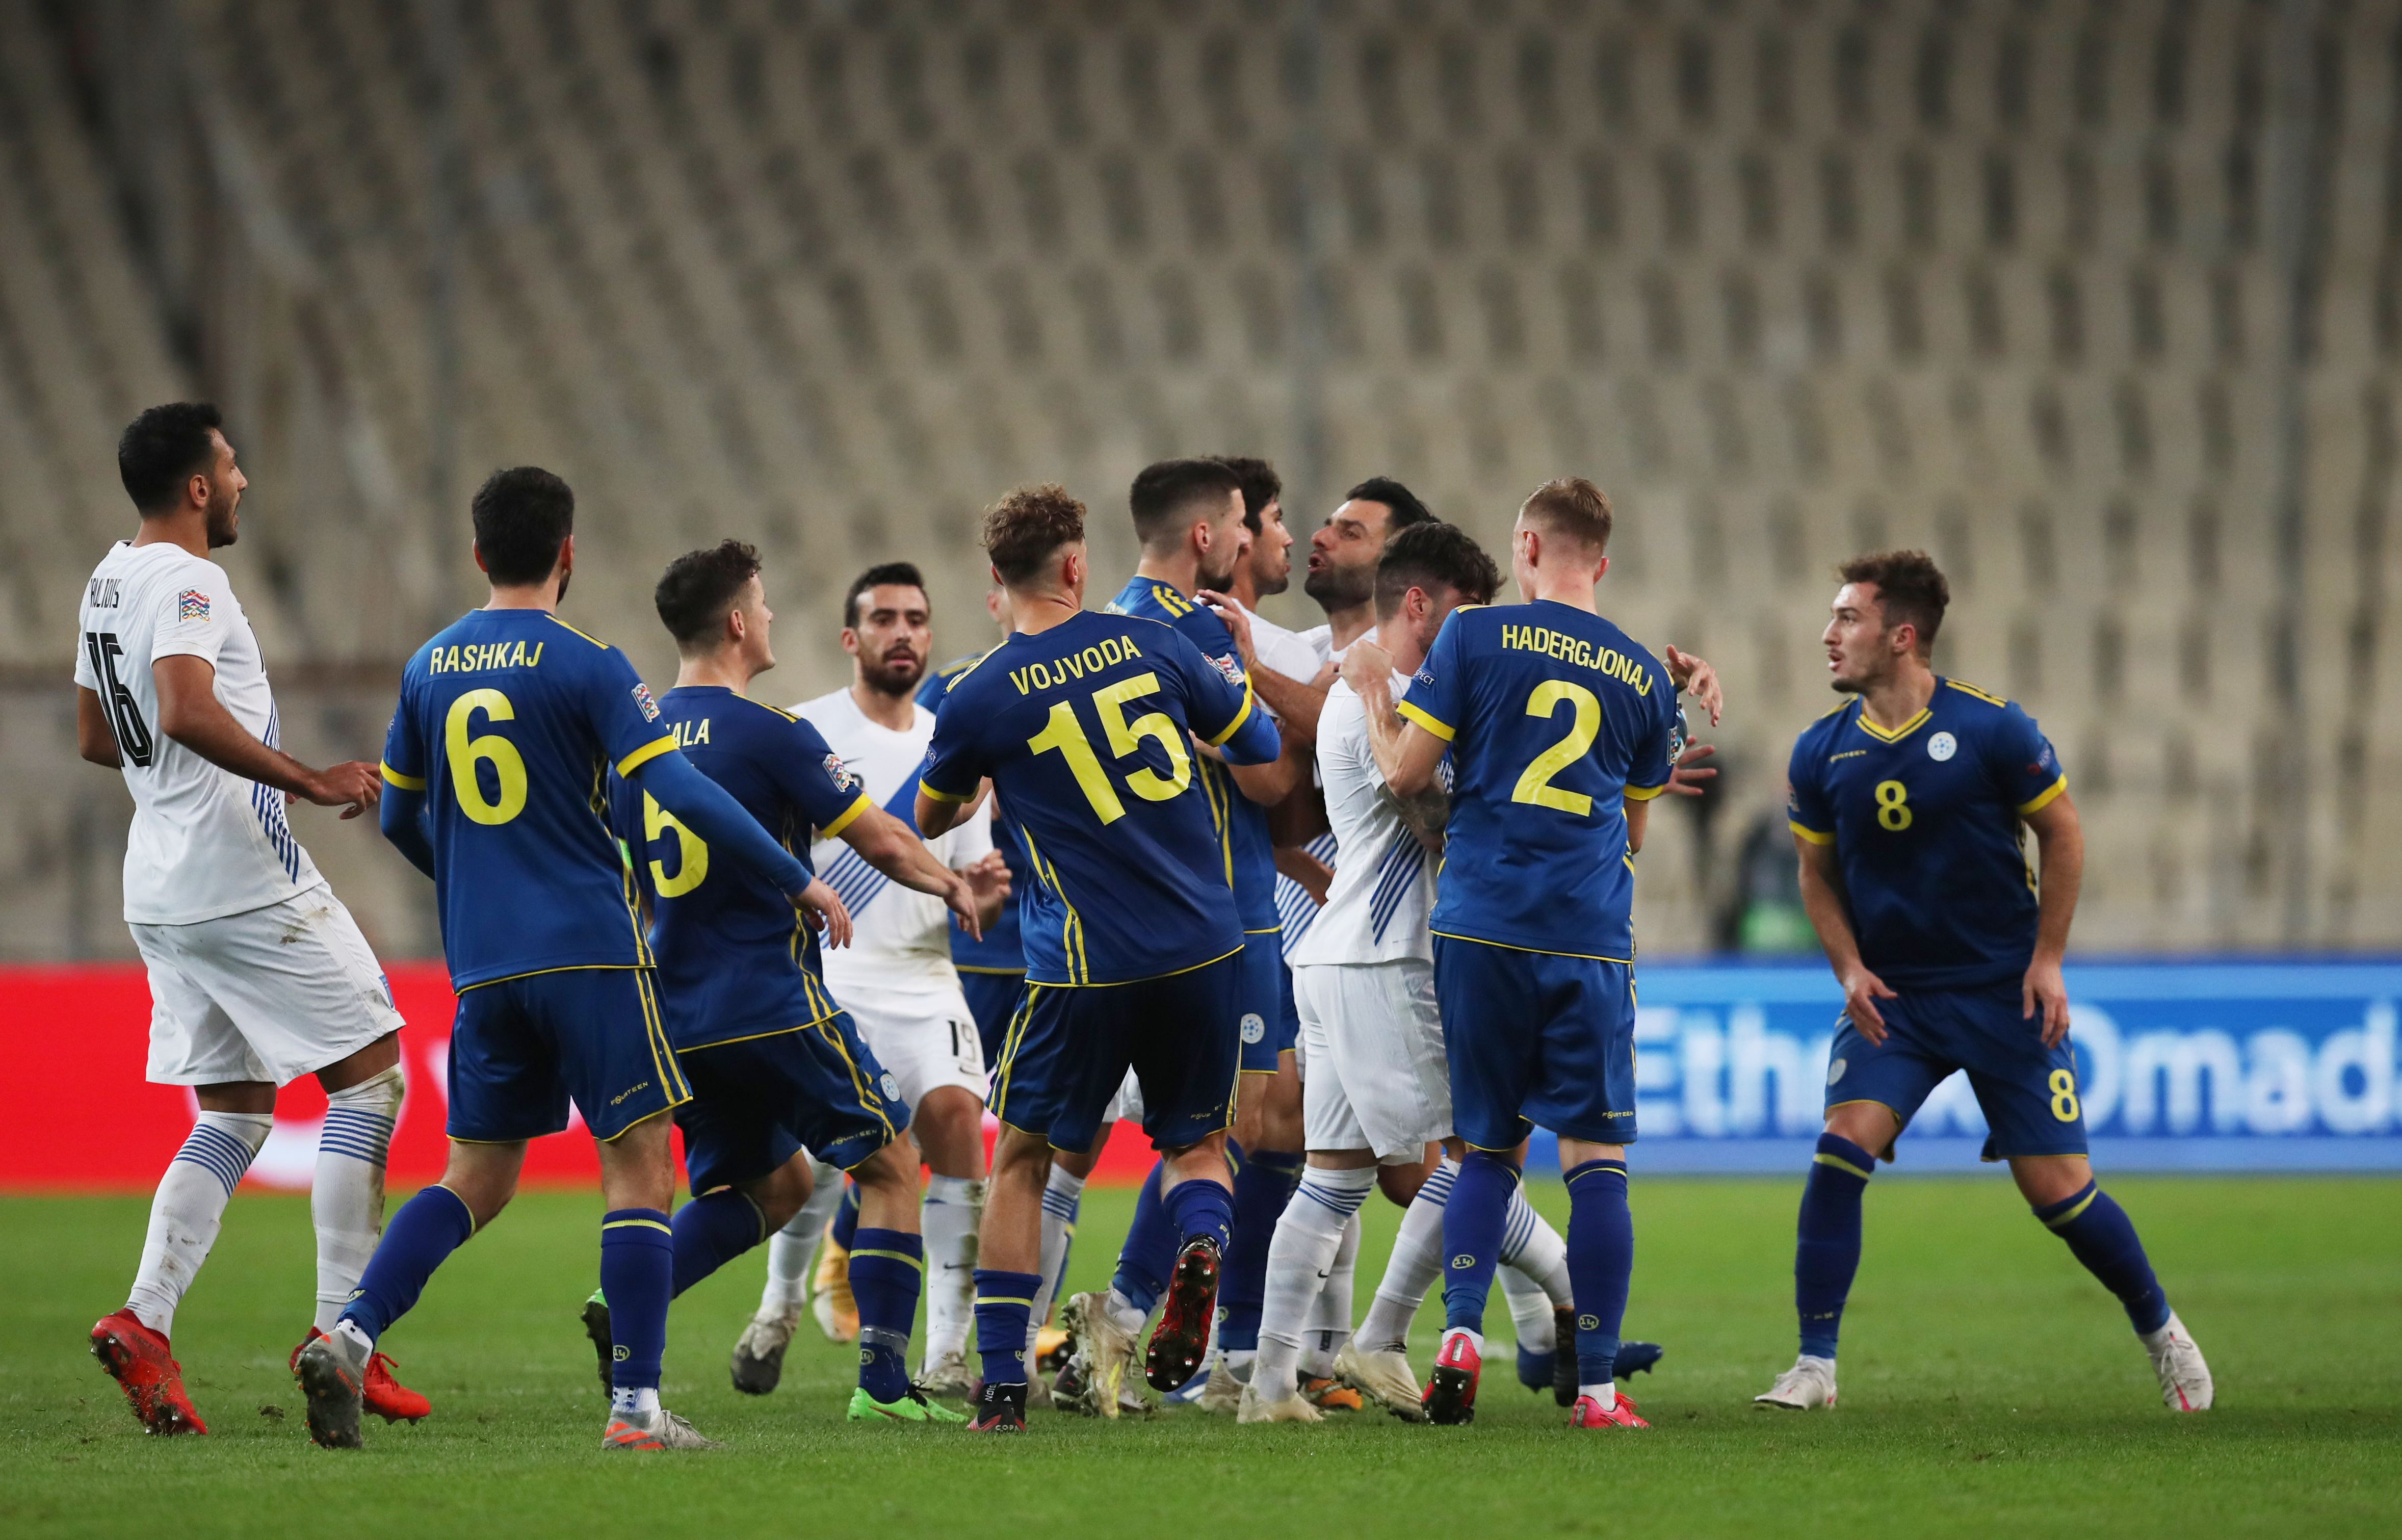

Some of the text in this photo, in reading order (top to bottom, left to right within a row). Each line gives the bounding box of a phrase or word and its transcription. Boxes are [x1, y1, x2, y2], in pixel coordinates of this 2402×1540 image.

[430, 641, 544, 675] RASHKAJ
[1009, 635, 1142, 695] VOJVODA
[1414, 669, 1435, 685] SPECT
[1502, 624, 1653, 697] HADERGJONAJ
[86, 632, 152, 767] 16
[666, 718, 710, 747] ALA
[445, 688, 528, 825] 6
[1027, 671, 1191, 826] 15
[1511, 679, 1601, 817] 2
[1874, 779, 1912, 831] 8
[643, 787, 709, 898] 5
[947, 1020, 977, 1064] 19
[2069, 1004, 2402, 1135] Omad
[2048, 1068, 2080, 1123] 8
